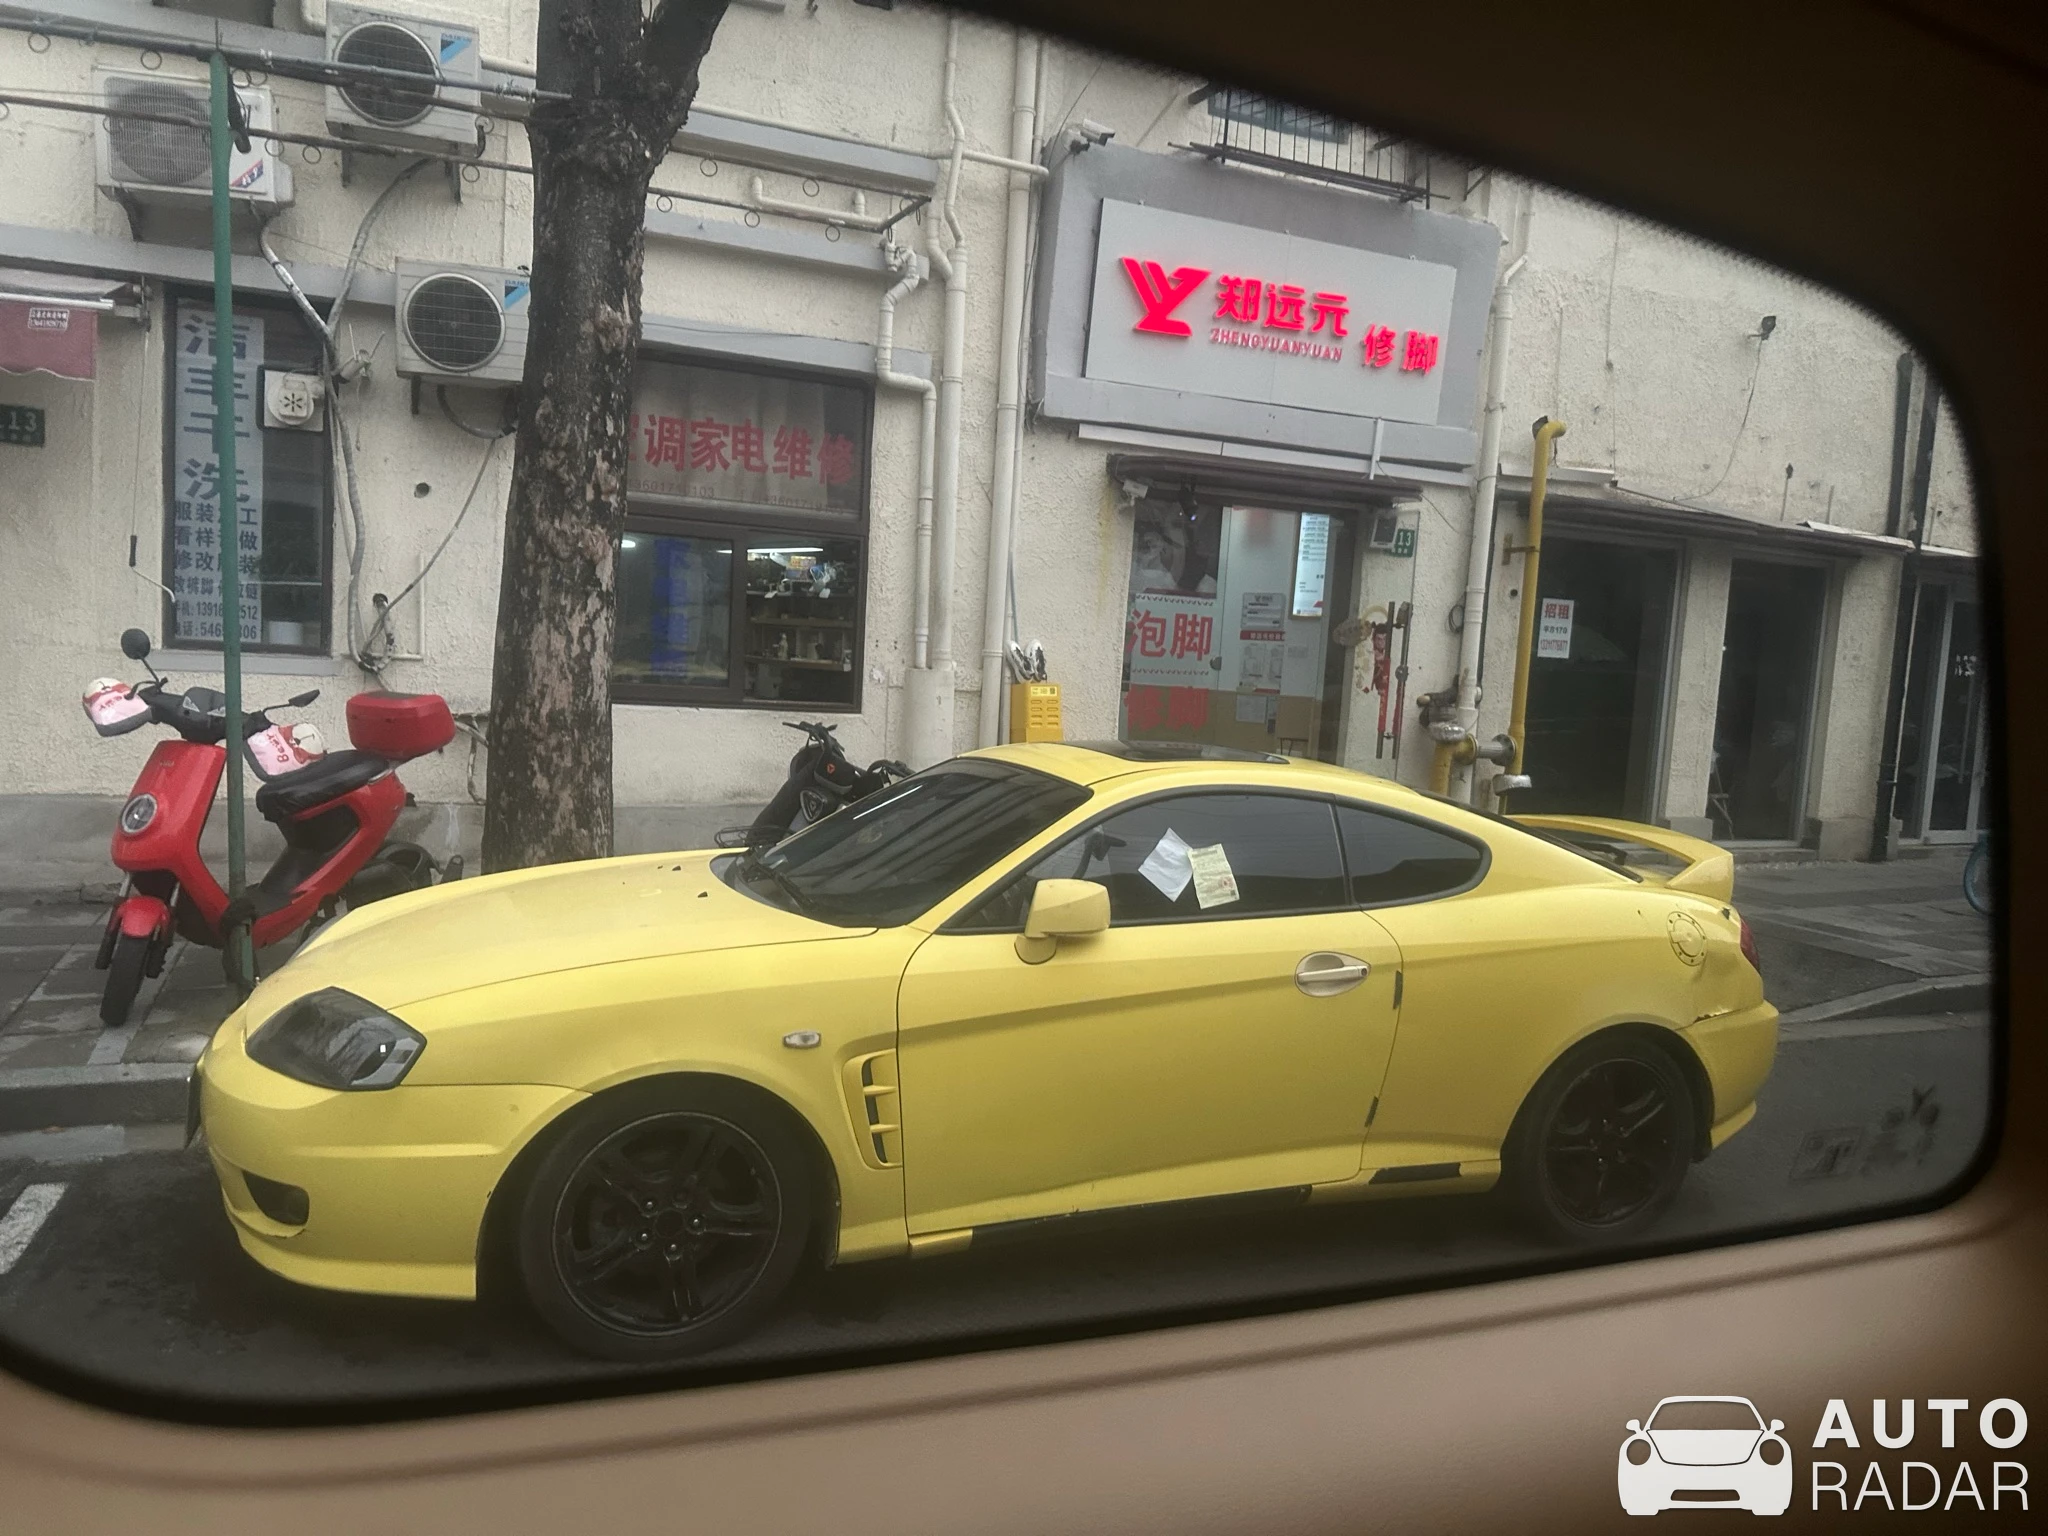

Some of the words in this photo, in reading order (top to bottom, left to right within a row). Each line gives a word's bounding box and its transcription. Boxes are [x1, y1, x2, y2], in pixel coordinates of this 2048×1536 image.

[1215, 275, 1350, 337] 郑远元
[1209, 327, 1343, 361] ZHENGYUANYUAN
[1363, 323, 1440, 374] 修脚
[0, 410, 37, 432] 13
[176, 501, 258, 525] 服装工
[176, 526, 258, 551] 看样做
[174, 549, 259, 576] 修改装
[1545, 603, 1569, 619] 招租
[1126, 608, 1214, 661] 泡脚
